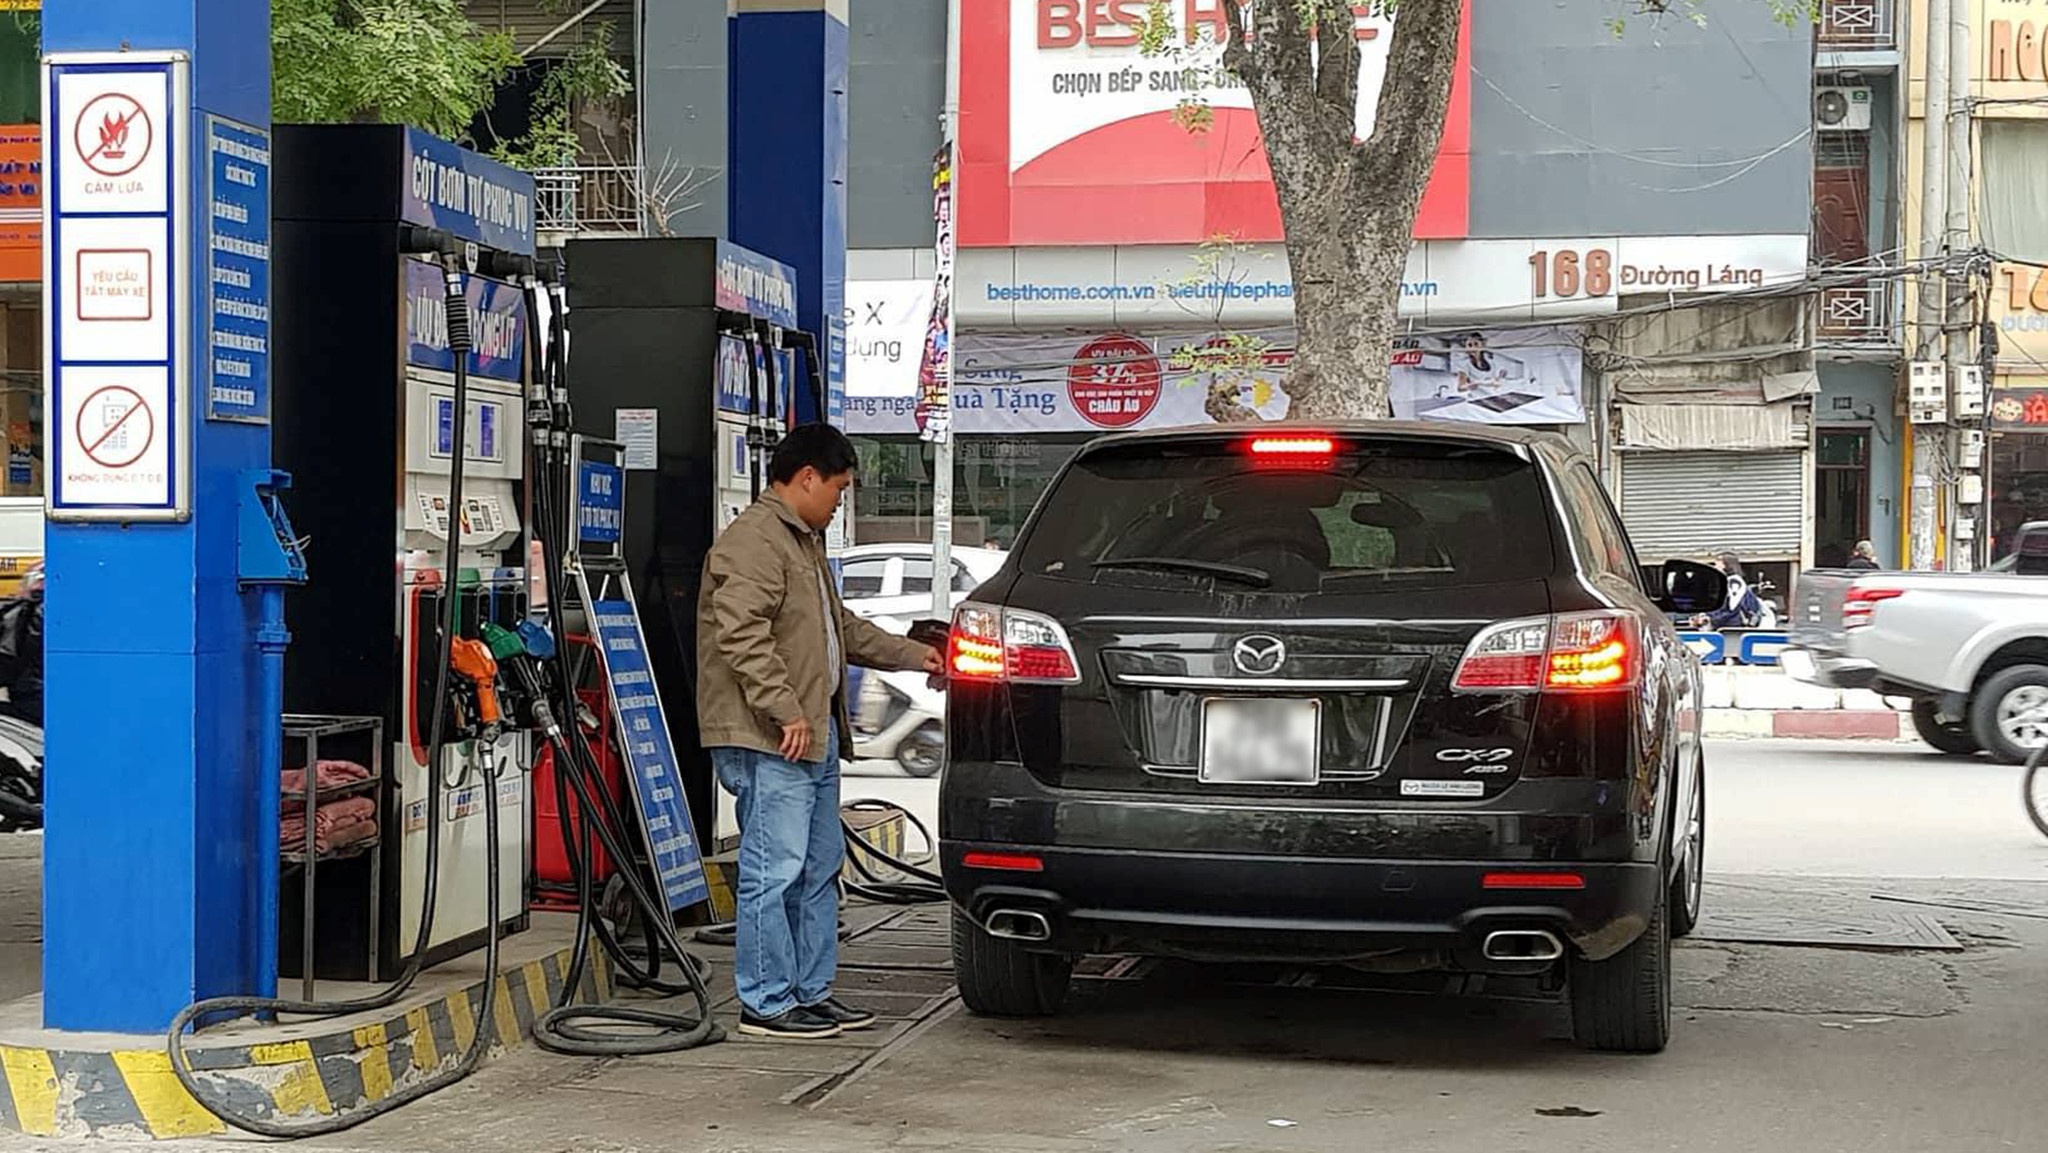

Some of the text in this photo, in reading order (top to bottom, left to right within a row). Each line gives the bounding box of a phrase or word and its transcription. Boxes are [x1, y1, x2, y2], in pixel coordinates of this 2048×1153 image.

[1038, 0, 1172, 48] BES
[1052, 72, 1102, 97] CHỌN
[1108, 64, 1143, 92] BẾP
[412, 149, 436, 209] CỘT
[438, 164, 465, 213] BƠM
[467, 175, 482, 226] TỰ
[514, 193, 528, 241] VỤ
[1529, 249, 1611, 298] 168
[1620, 264, 1762, 289] Đường Láng
[987, 282, 1154, 300] besthome.com.vn
[865, 301, 885, 326] X
[955, 388, 984, 409] uà
[991, 387, 1056, 415] Tặng
[1089, 398, 1120, 413] CHÂU
